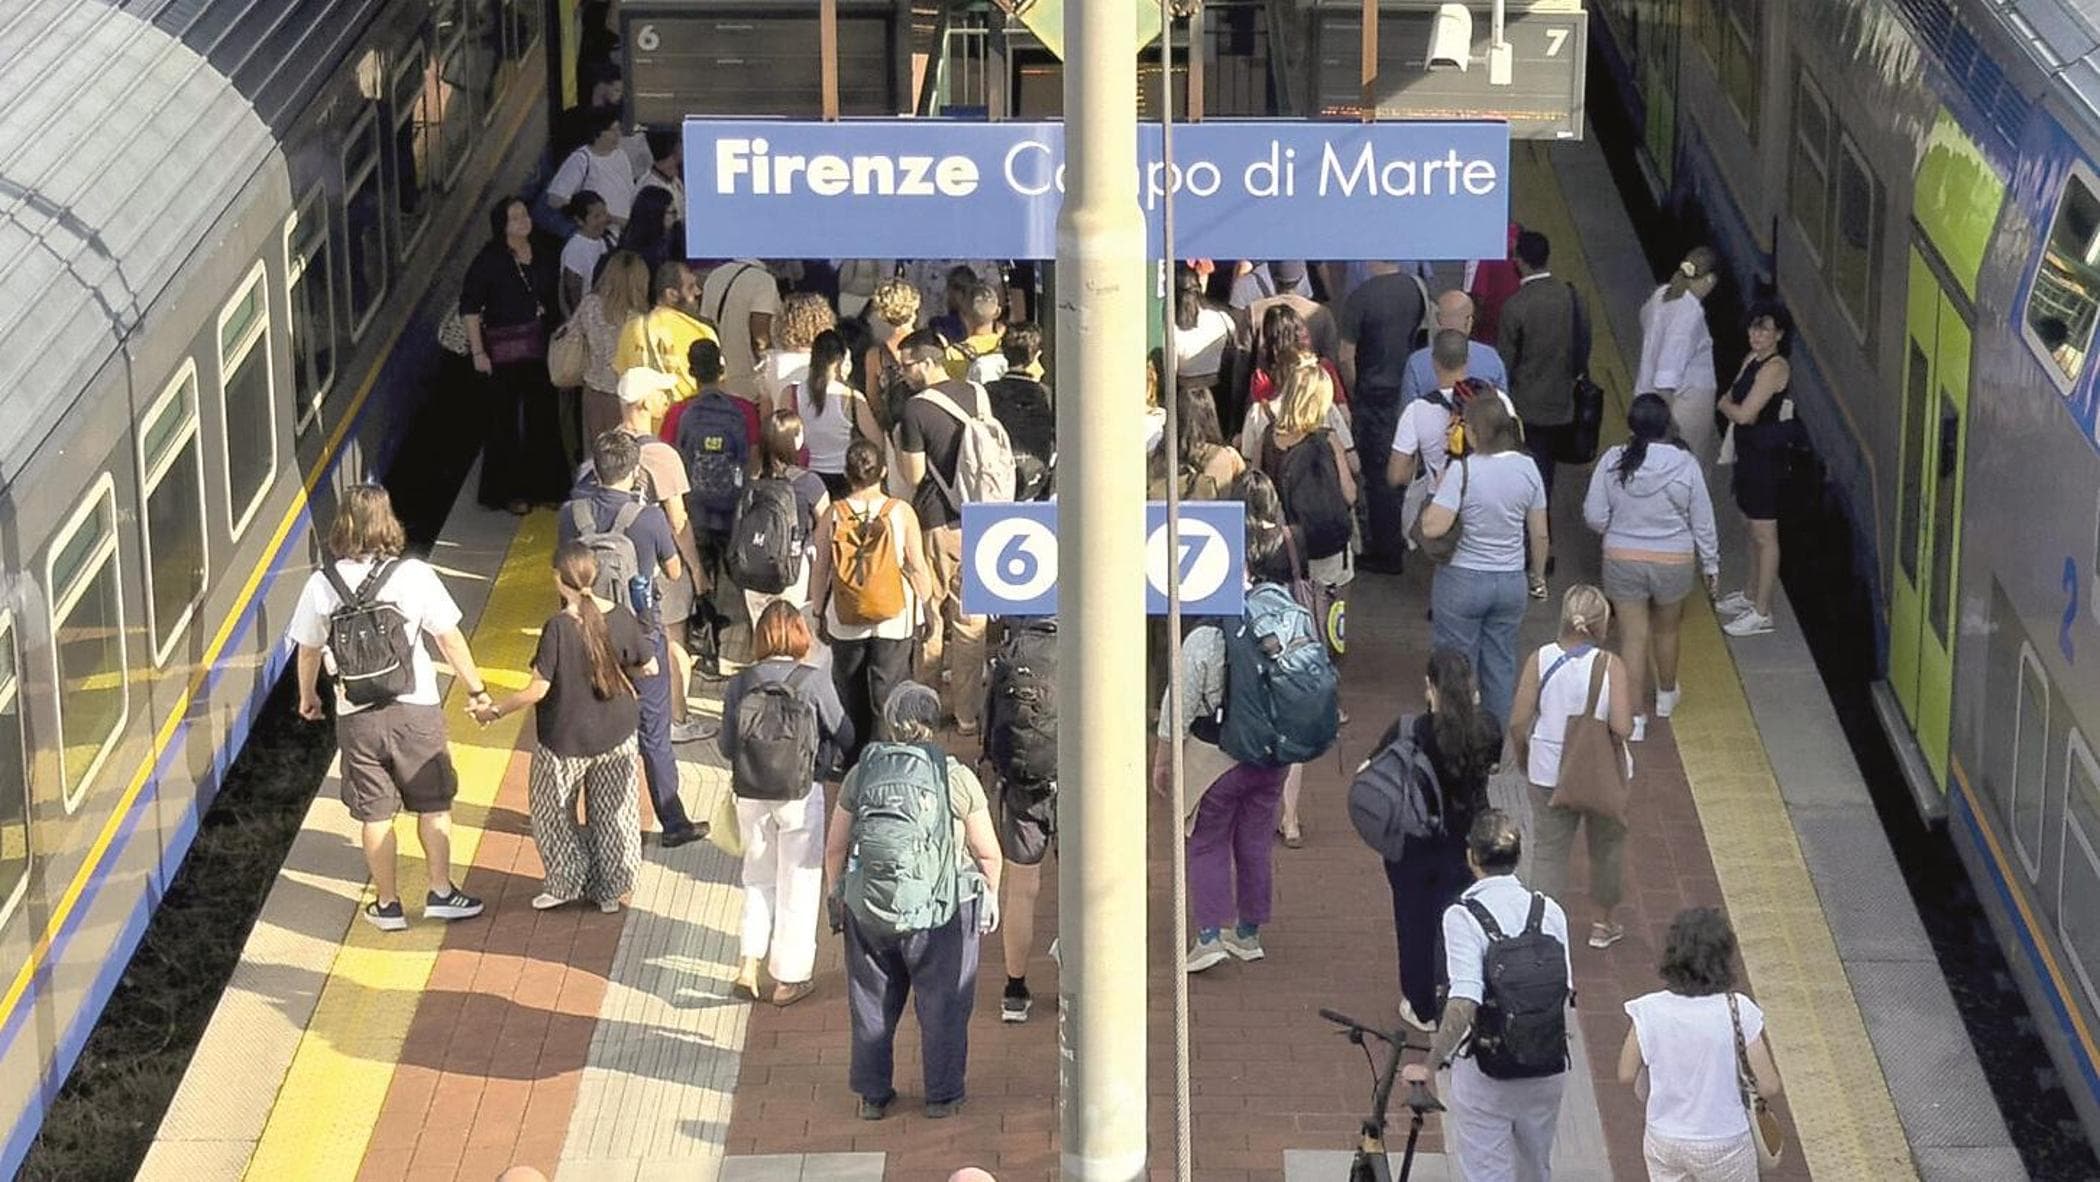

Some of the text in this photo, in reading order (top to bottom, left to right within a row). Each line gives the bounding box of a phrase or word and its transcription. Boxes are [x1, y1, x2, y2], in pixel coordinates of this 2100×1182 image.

[637, 24, 660, 51] 6
[1546, 29, 1569, 56] 7
[716, 138, 1497, 211] Firenze Cpo di Marte
[996, 534, 1211, 586] 6 7
[2060, 555, 2079, 667] 2
